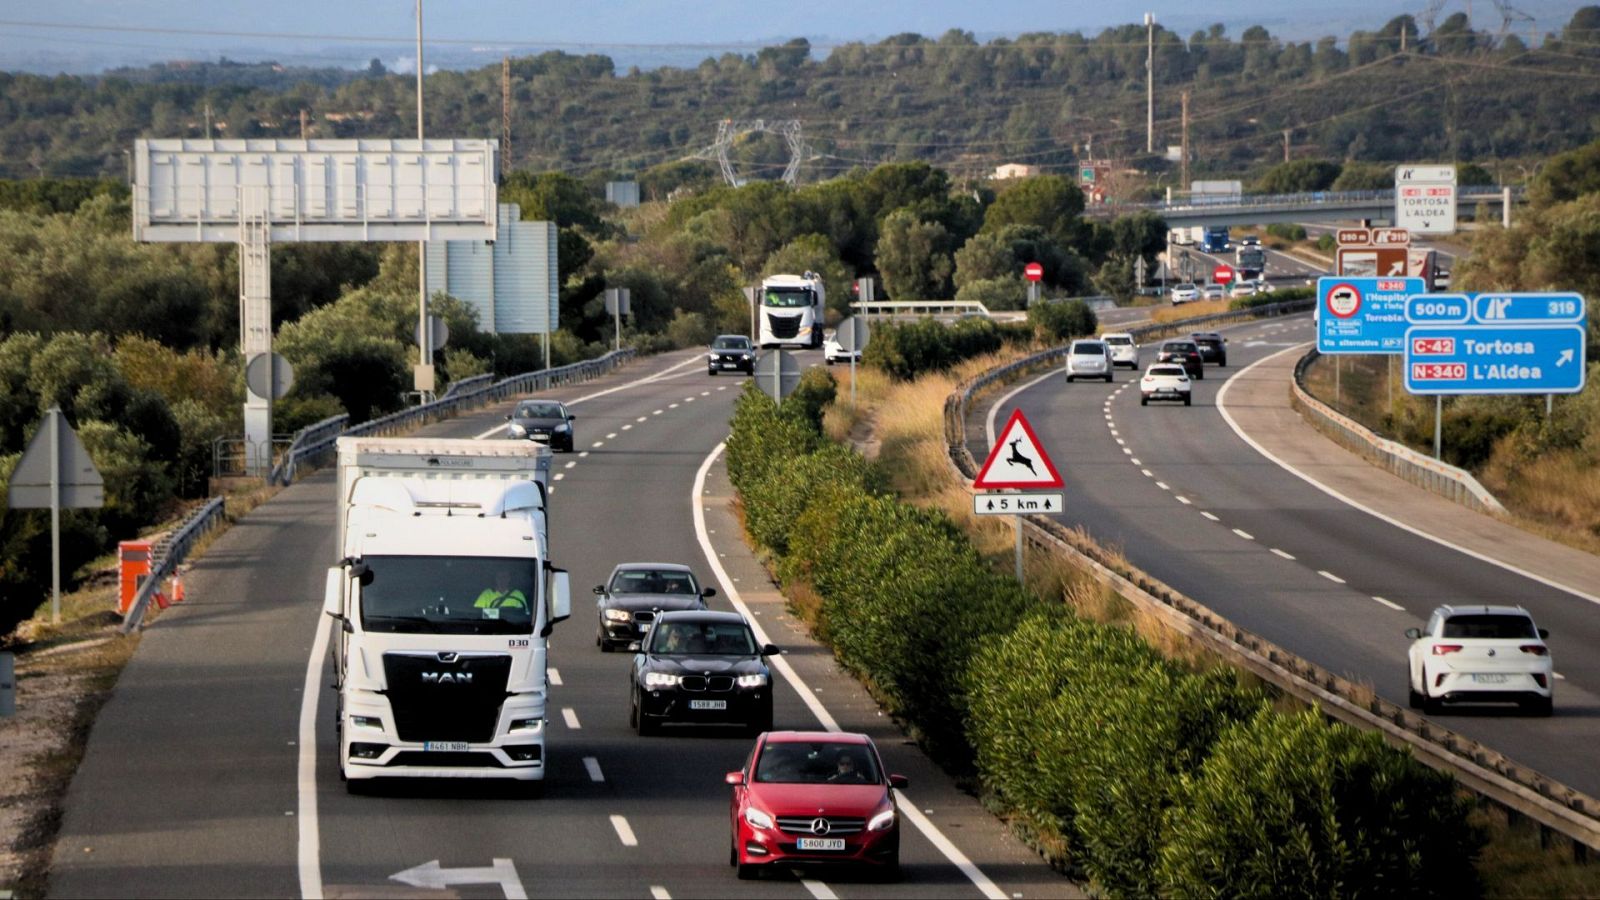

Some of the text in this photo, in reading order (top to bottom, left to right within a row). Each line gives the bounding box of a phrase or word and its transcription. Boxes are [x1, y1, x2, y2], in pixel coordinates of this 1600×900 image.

[1406, 209, 1445, 217] L'ALDEA
[1391, 232, 1407, 241] 319
[1378, 281, 1405, 290] N-340
[1415, 303, 1461, 316] 500 m
[1548, 301, 1576, 315] 319
[1414, 340, 1535, 354] C-42 Tortosa
[1414, 365, 1542, 380] N-340 L'Aldea
[1000, 499, 1038, 509] 5 km
[421, 672, 473, 683] MAN
[803, 839, 842, 848] 5800 JYD
